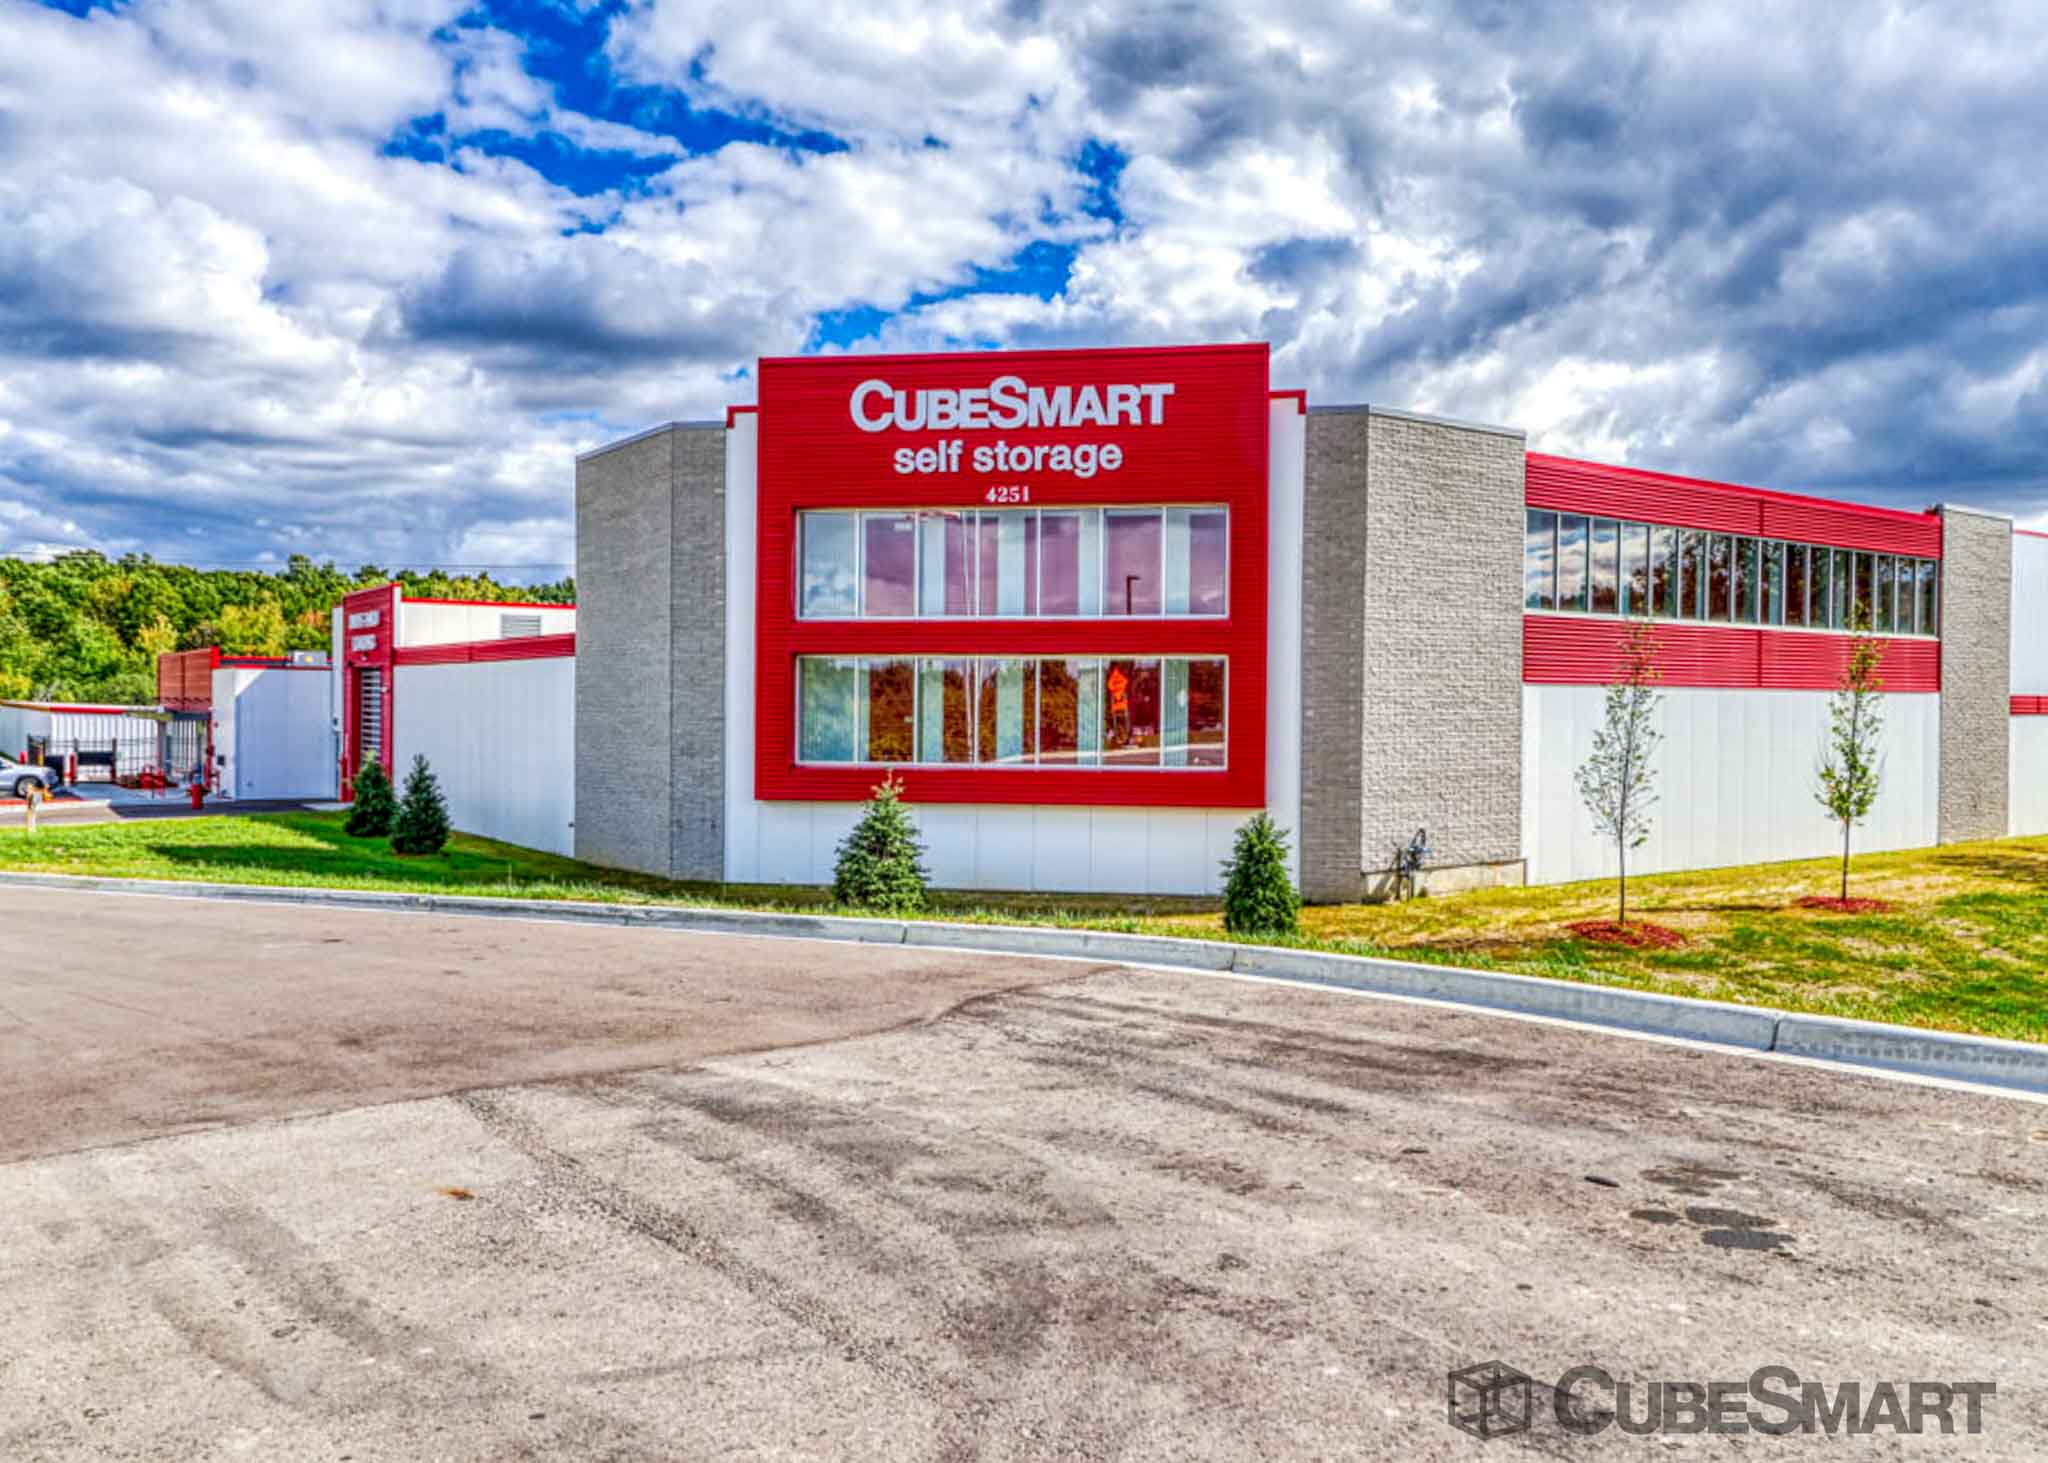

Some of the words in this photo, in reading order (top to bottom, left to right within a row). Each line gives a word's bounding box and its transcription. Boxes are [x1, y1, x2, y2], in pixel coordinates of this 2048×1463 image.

[850, 377, 1175, 432] CUBESMART
[894, 440, 963, 474] self
[972, 441, 1123, 478] storage
[985, 486, 1030, 503] 4251
